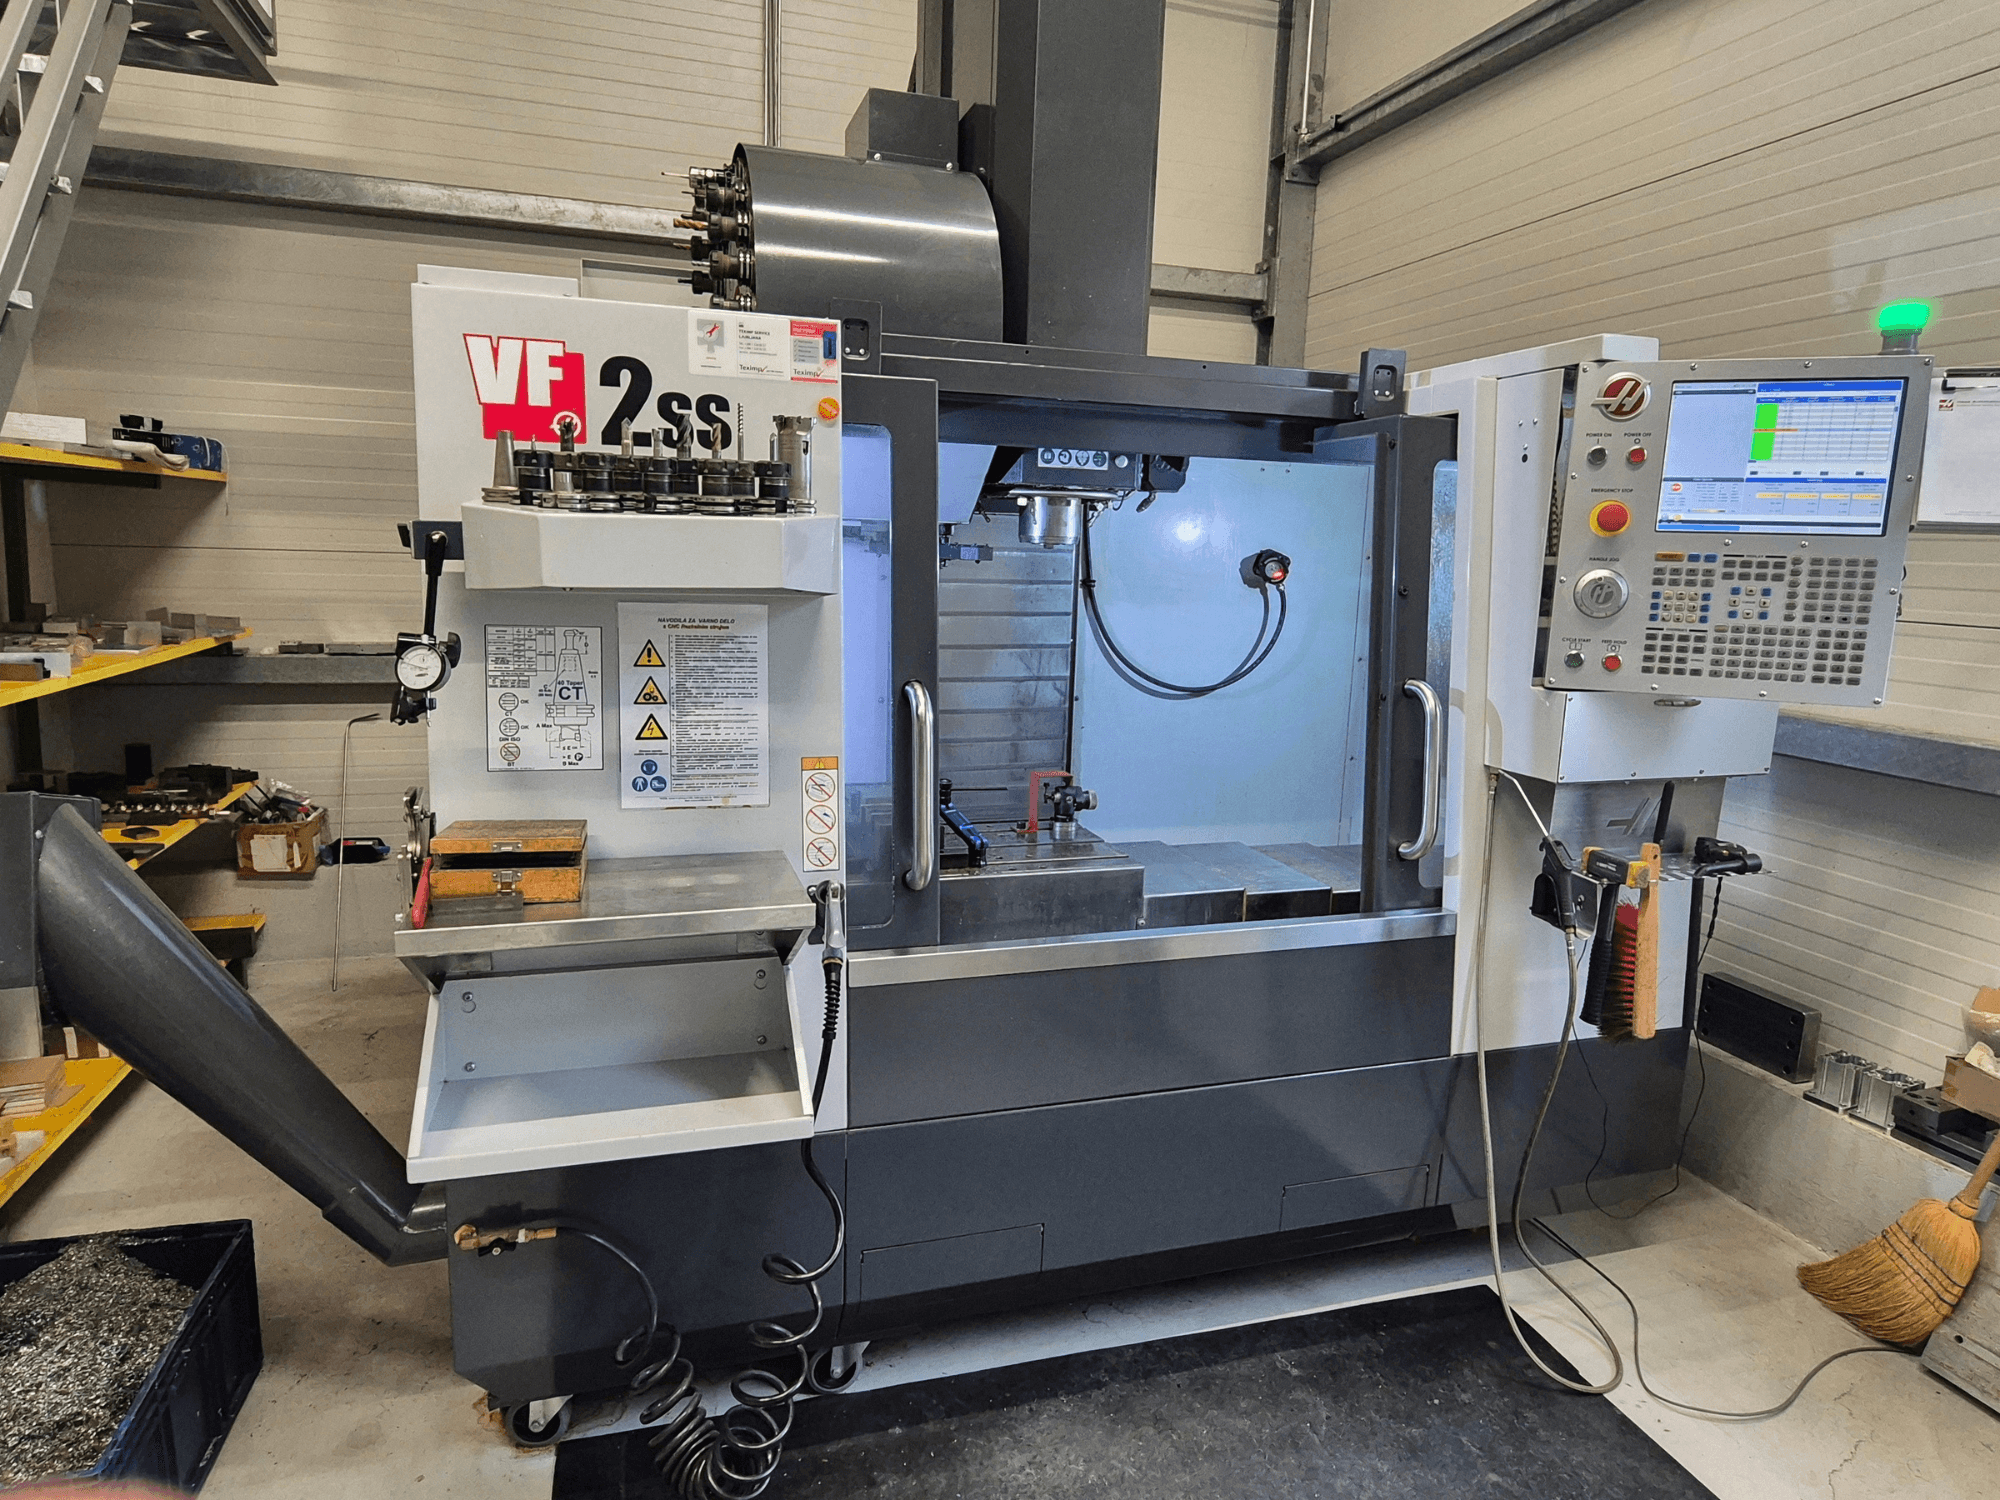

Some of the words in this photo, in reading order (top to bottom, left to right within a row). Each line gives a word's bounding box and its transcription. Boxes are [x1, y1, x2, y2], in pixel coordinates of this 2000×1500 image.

[463, 333, 565, 407] VF
[739, 364, 762, 372] Teximp
[794, 368, 818, 377] Teximp
[558, 686, 583, 700] CT
